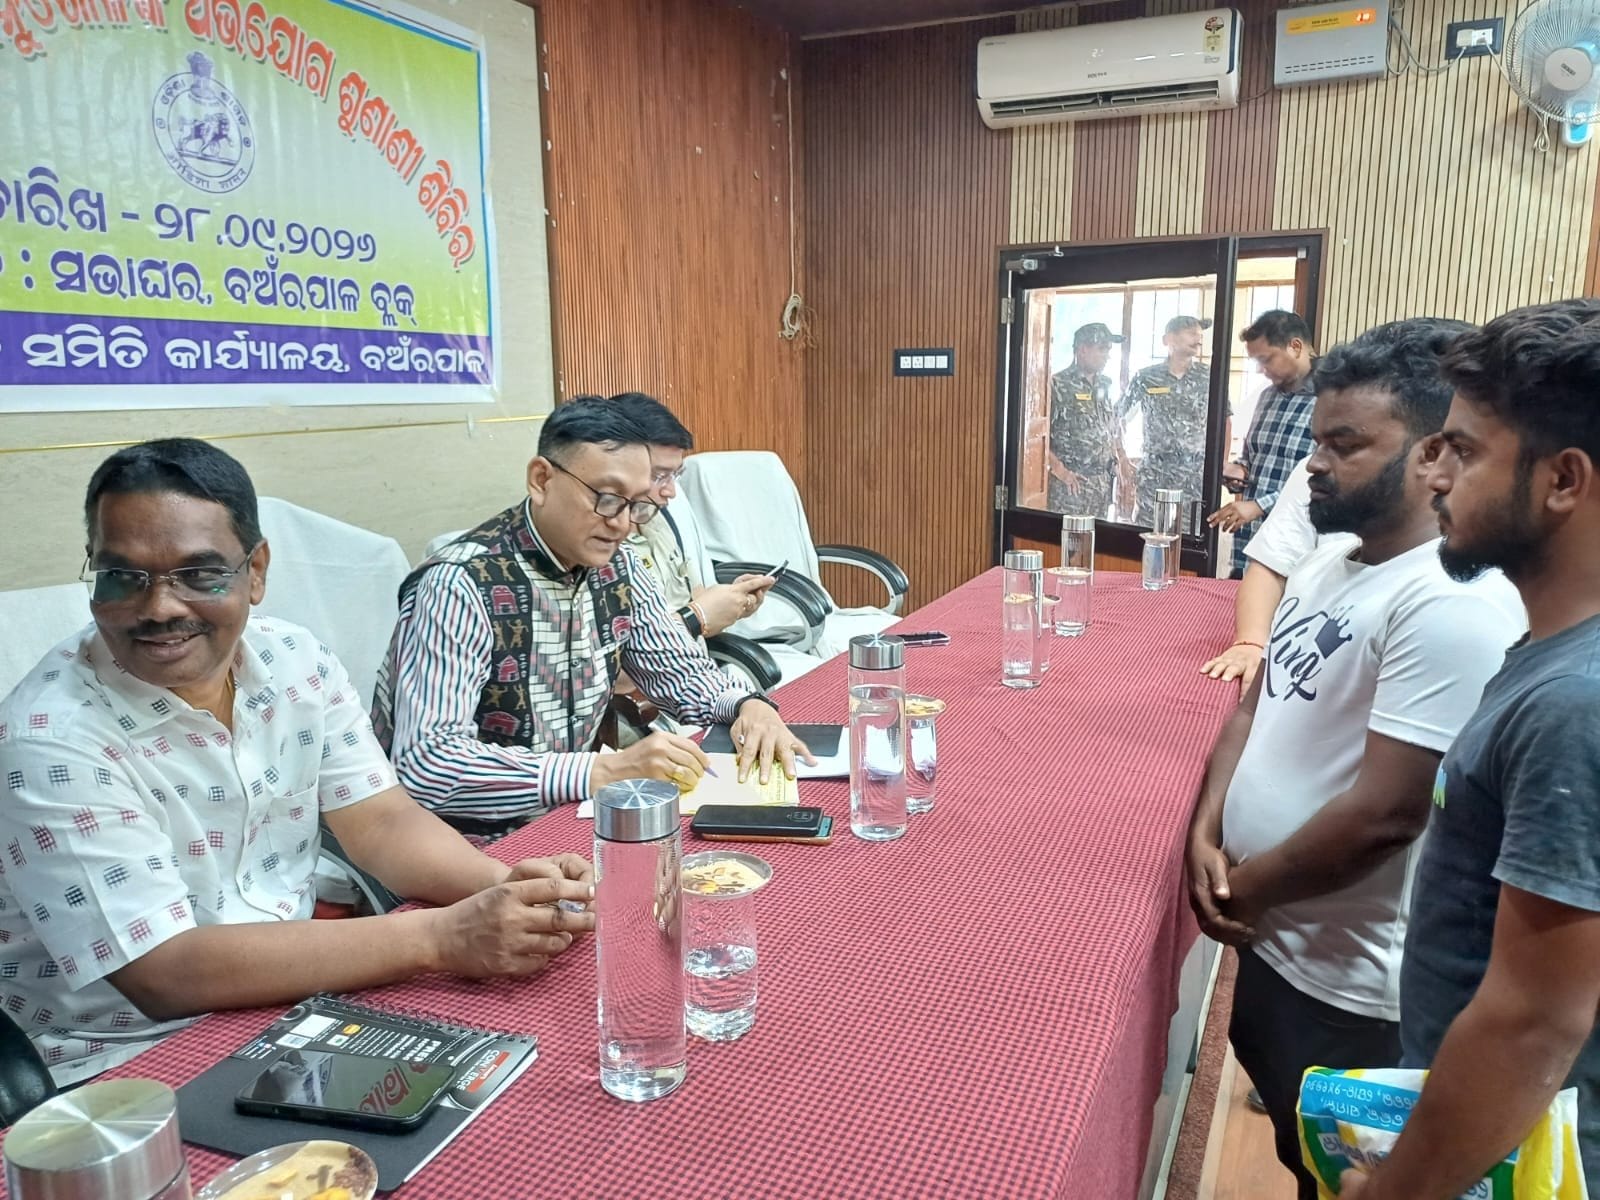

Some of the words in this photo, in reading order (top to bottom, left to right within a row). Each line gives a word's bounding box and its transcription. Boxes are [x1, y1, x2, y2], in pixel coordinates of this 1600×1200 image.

[418, 159, 475, 268] ଶିବିର
[51, 250, 212, 305] ସଭାଘର,
[224, 255, 360, 311] ବଅଁରପାଳ
[370, 281, 417, 326] ବ୍ଲକ୍
[22, 323, 149, 369] ସମିତି
[360, 335, 486, 373] ବଅଁରପାଳ
[456, 1049, 500, 1091] CONVERGE
